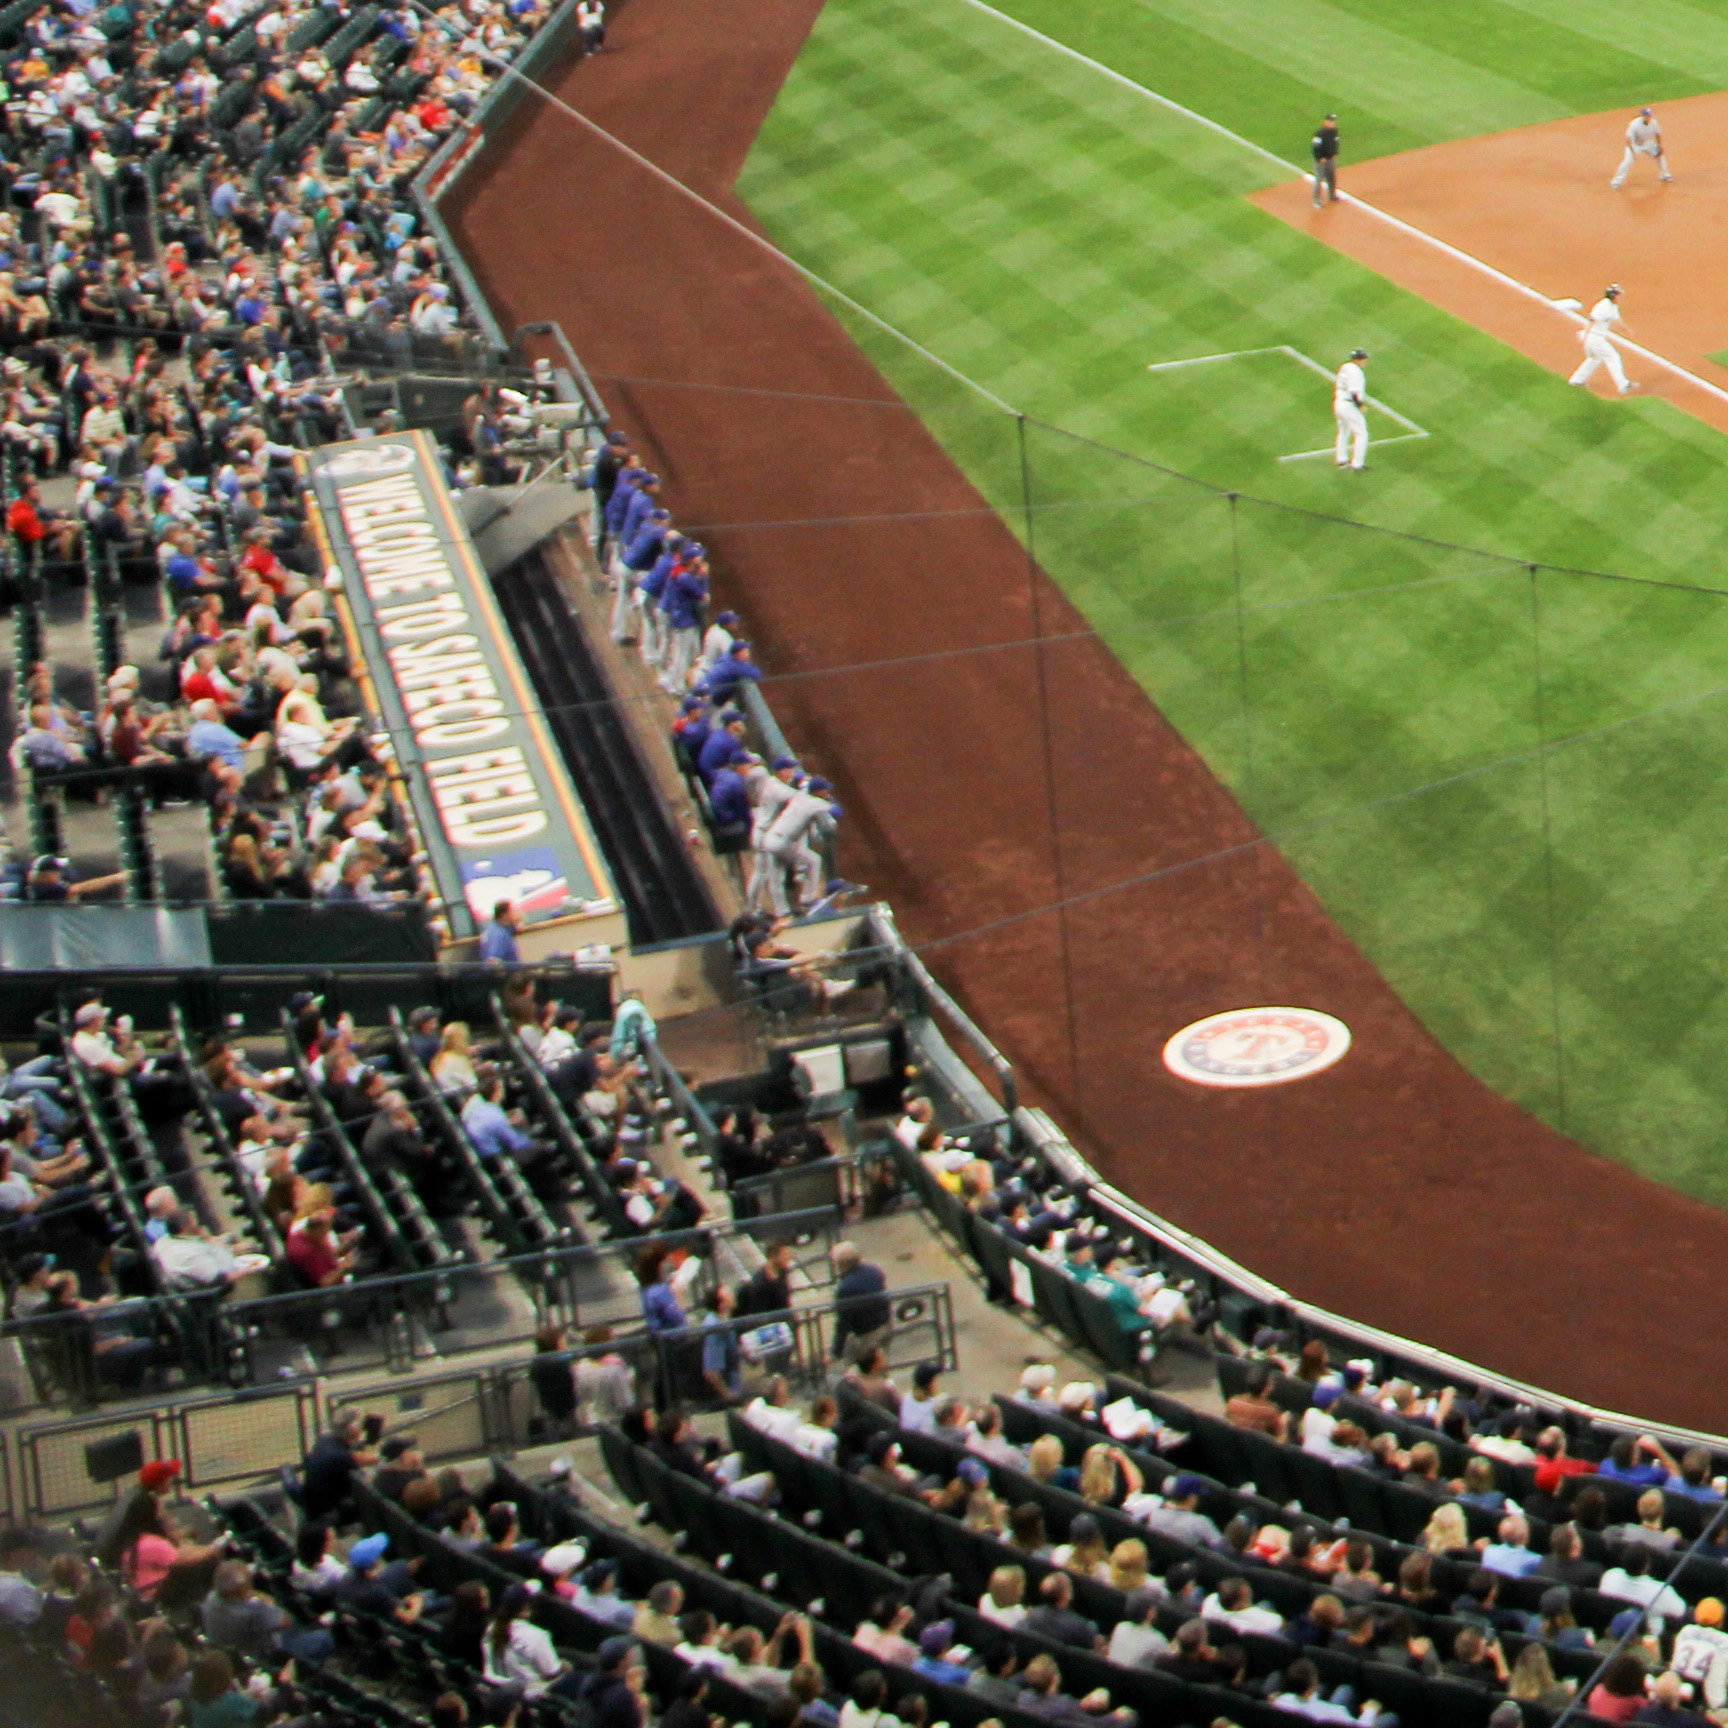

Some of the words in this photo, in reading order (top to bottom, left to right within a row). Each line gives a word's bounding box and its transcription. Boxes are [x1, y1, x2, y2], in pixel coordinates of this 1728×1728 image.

[337, 473, 458, 600] WELCOME
[374, 590, 471, 640] TO
[386, 633, 512, 749] SAFECO
[424, 745, 549, 848] FIELD
